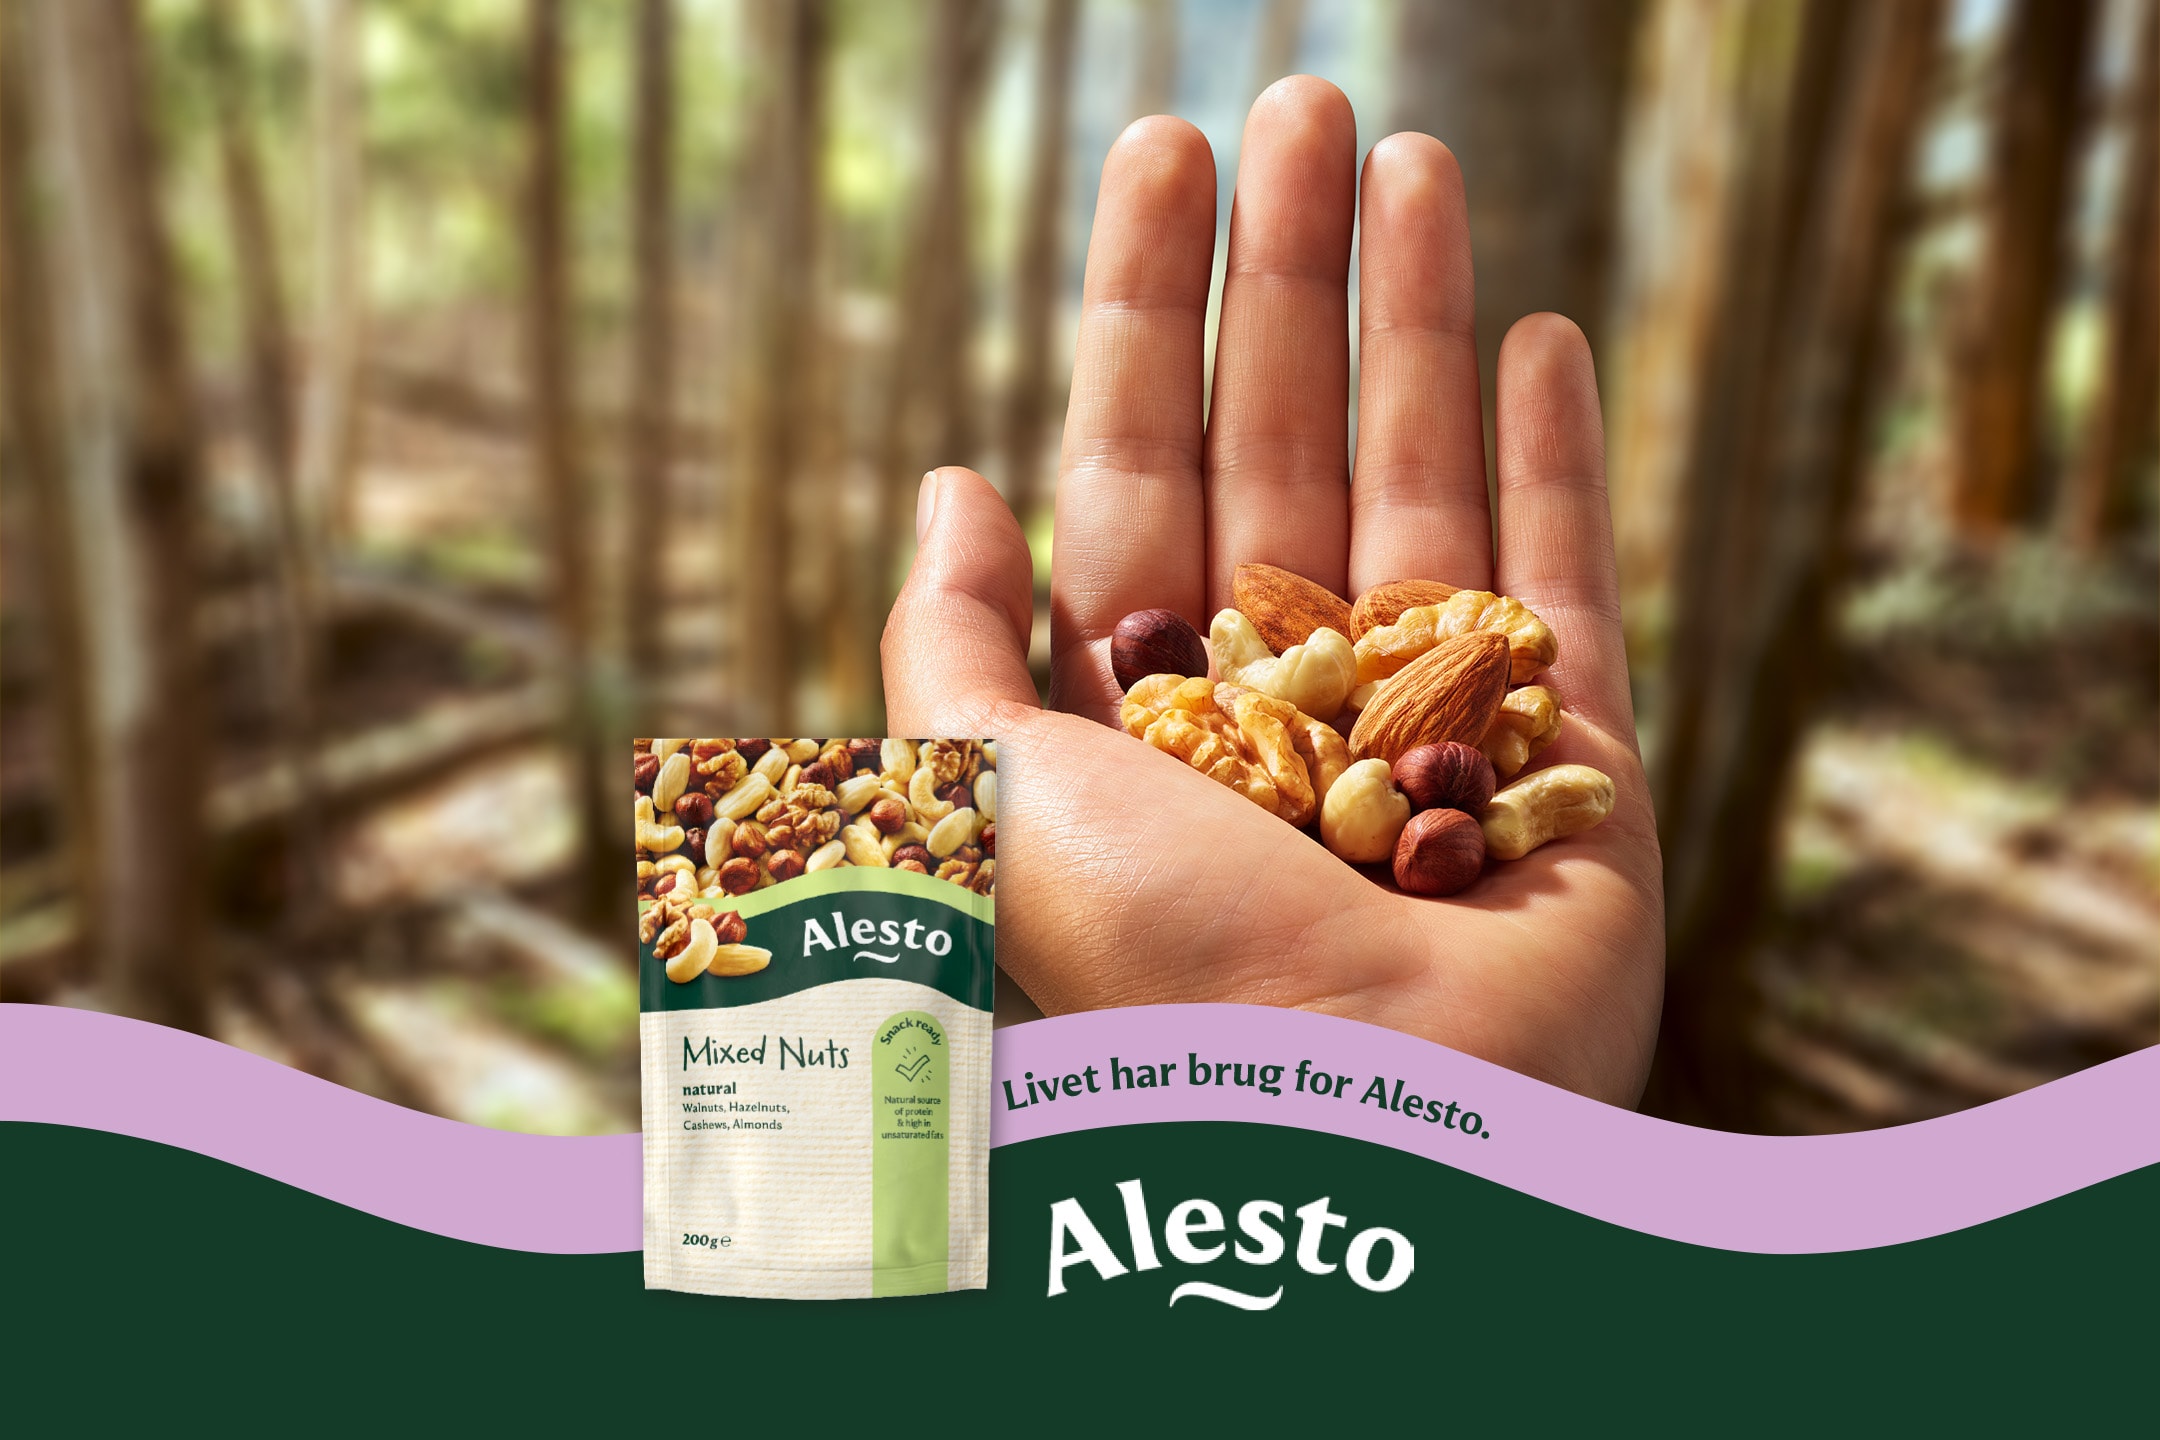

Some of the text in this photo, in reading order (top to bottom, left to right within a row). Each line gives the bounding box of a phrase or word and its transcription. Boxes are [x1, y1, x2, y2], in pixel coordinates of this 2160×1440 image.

[802, 911, 952, 957] Alesto
[880, 1017, 942, 1046] Snack ready
[683, 1034, 850, 1071] Mixed Nuts
[682, 1082, 737, 1096] natural
[884, 1095, 941, 1105] Natural source
[682, 1102, 790, 1114] Walnuts, Hazelnuts,
[894, 1107, 933, 1117] of protein
[683, 1118, 783, 1131] Cashews, Almonds
[897, 1118, 931, 1130] & high in
[881, 1130, 944, 1140] unsaturated fats
